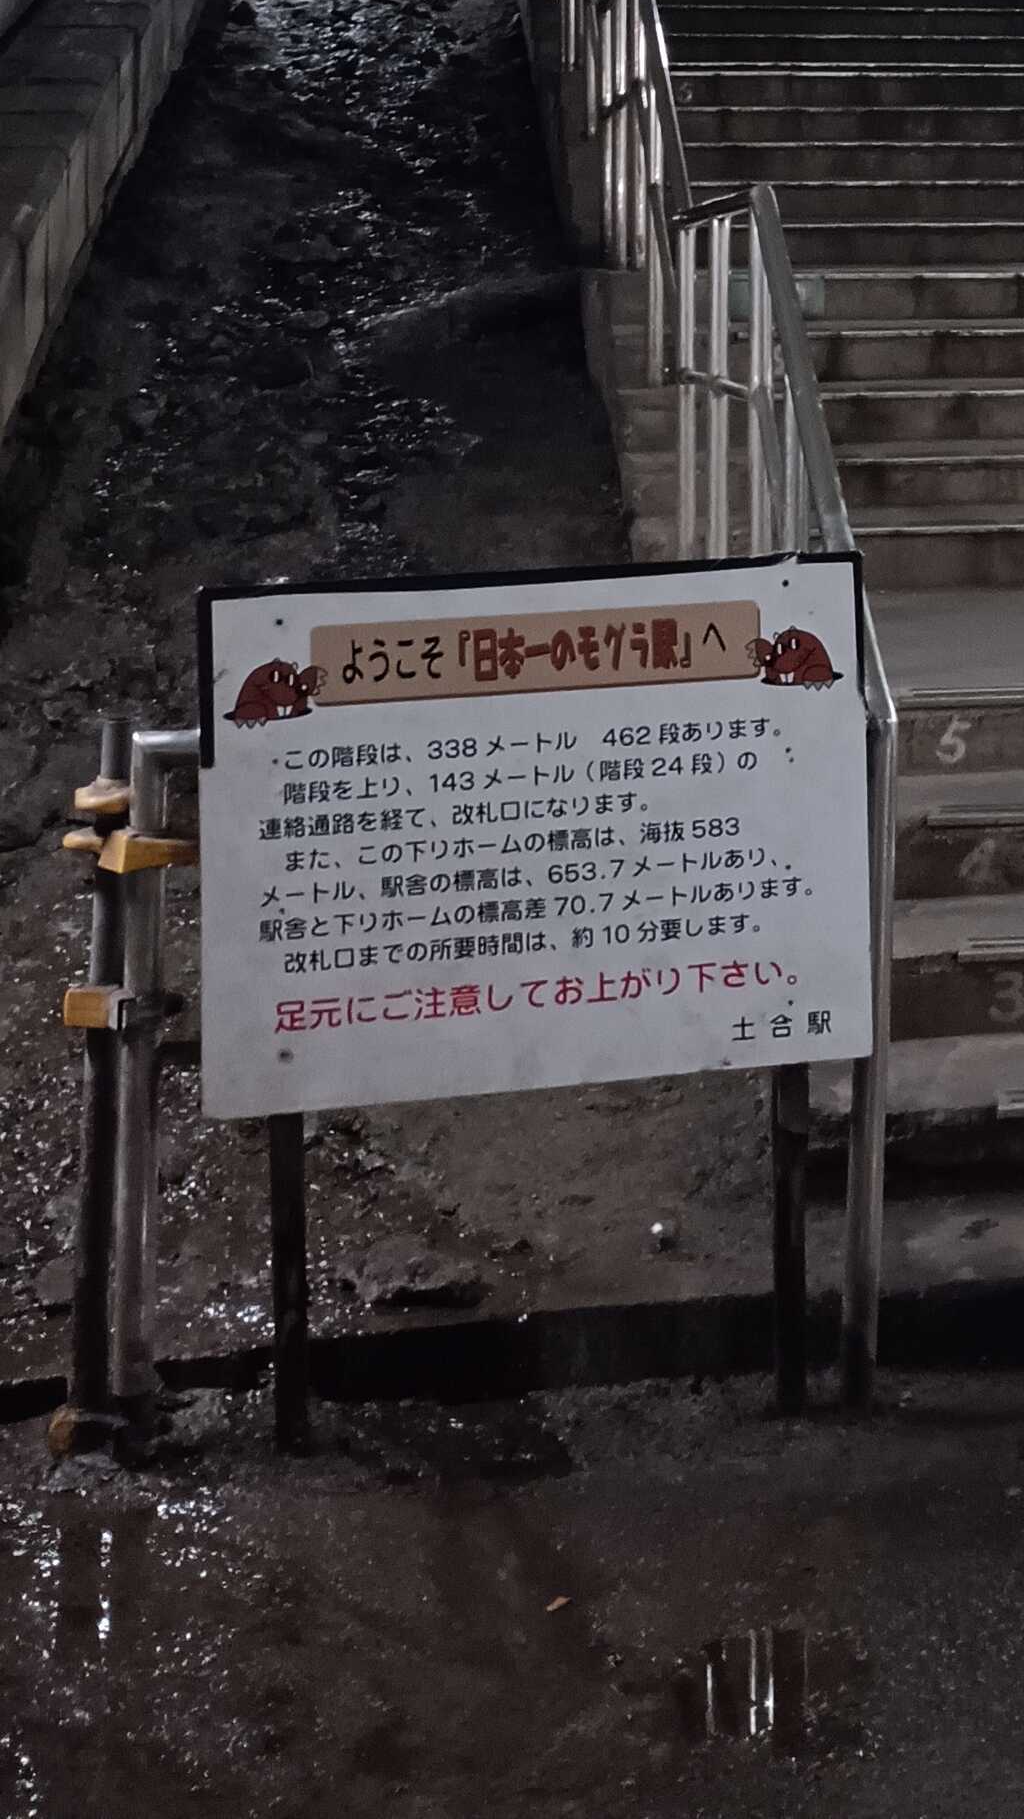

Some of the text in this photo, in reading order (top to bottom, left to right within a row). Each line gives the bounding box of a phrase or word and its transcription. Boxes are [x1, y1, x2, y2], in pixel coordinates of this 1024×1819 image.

[284, 718, 781, 770] この階段は、338メートル 462段あります。
[935, 714, 972, 764] 5
[283, 751, 757, 806] 階段を上り、143メートル（階段24段）の
[259, 791, 648, 840] 連絡通路を経て、改札口になります。
[285, 817, 740, 872] また、この下りホームの標高は、海抜583
[260, 847, 777, 907] メートル、駅舎の標高は、653.7メートルあり、
[259, 877, 813, 942] 駅舎と下りホームの標高差70.7メートルあります。
[284, 914, 760, 974] 改札口までの所要時間は、約10分要します。
[274, 960, 798, 1034] 足元にご注意してお上がり下さい。
[732, 1010, 832, 1042] 土合駅
